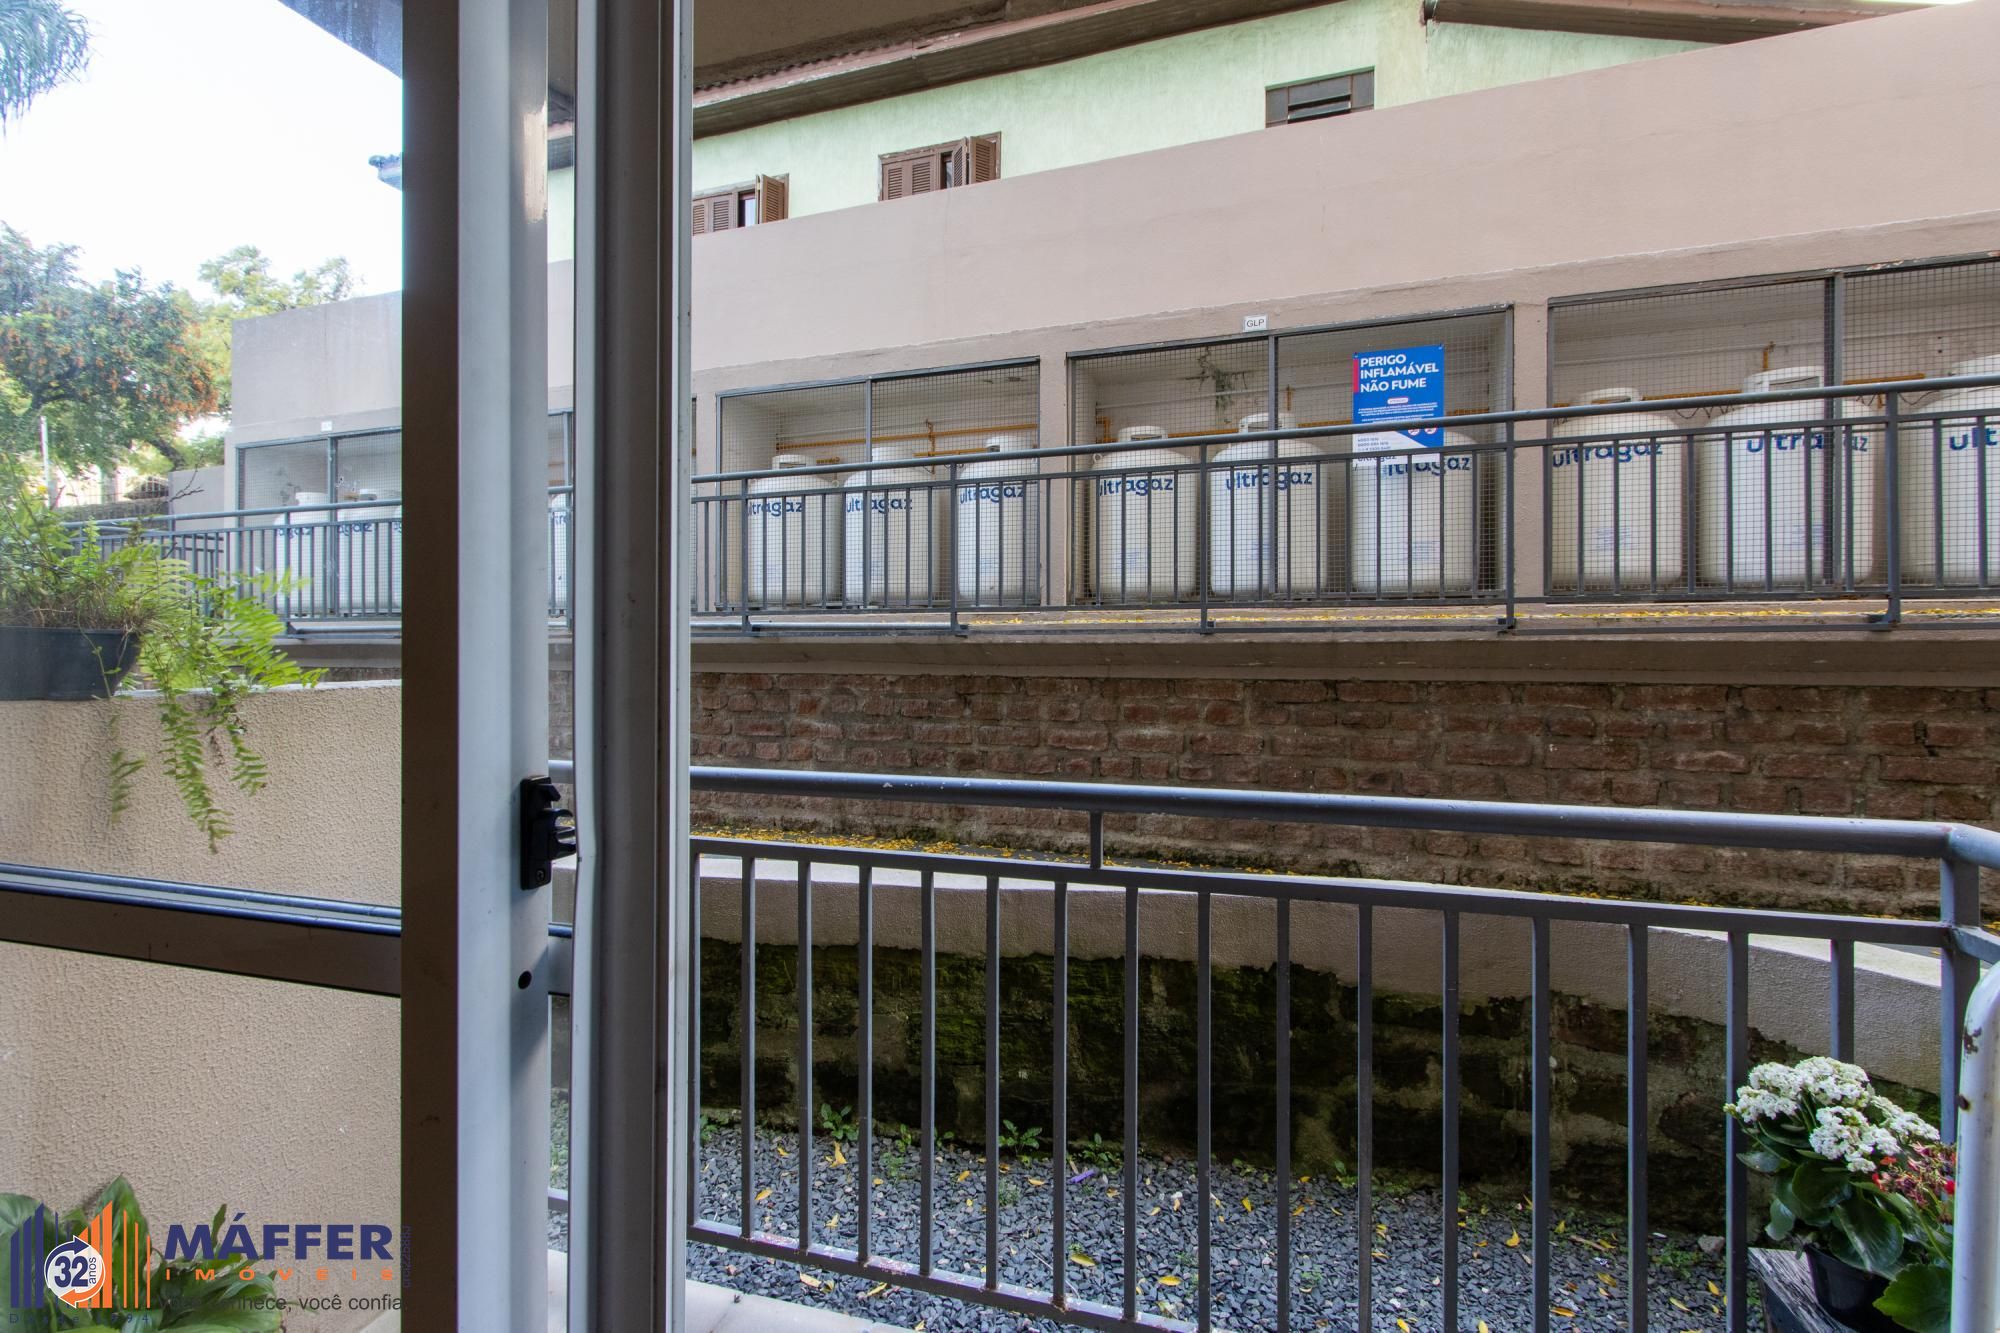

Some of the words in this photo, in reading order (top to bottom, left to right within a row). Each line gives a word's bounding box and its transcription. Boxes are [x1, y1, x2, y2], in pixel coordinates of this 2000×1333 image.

[1246, 318, 1265, 328] GLP
[1360, 353, 1407, 368] PERIGO
[1360, 362, 1439, 379] INFLAMÁVEL
[1360, 379, 1389, 393] NÃO
[1391, 377, 1427, 390] FUME
